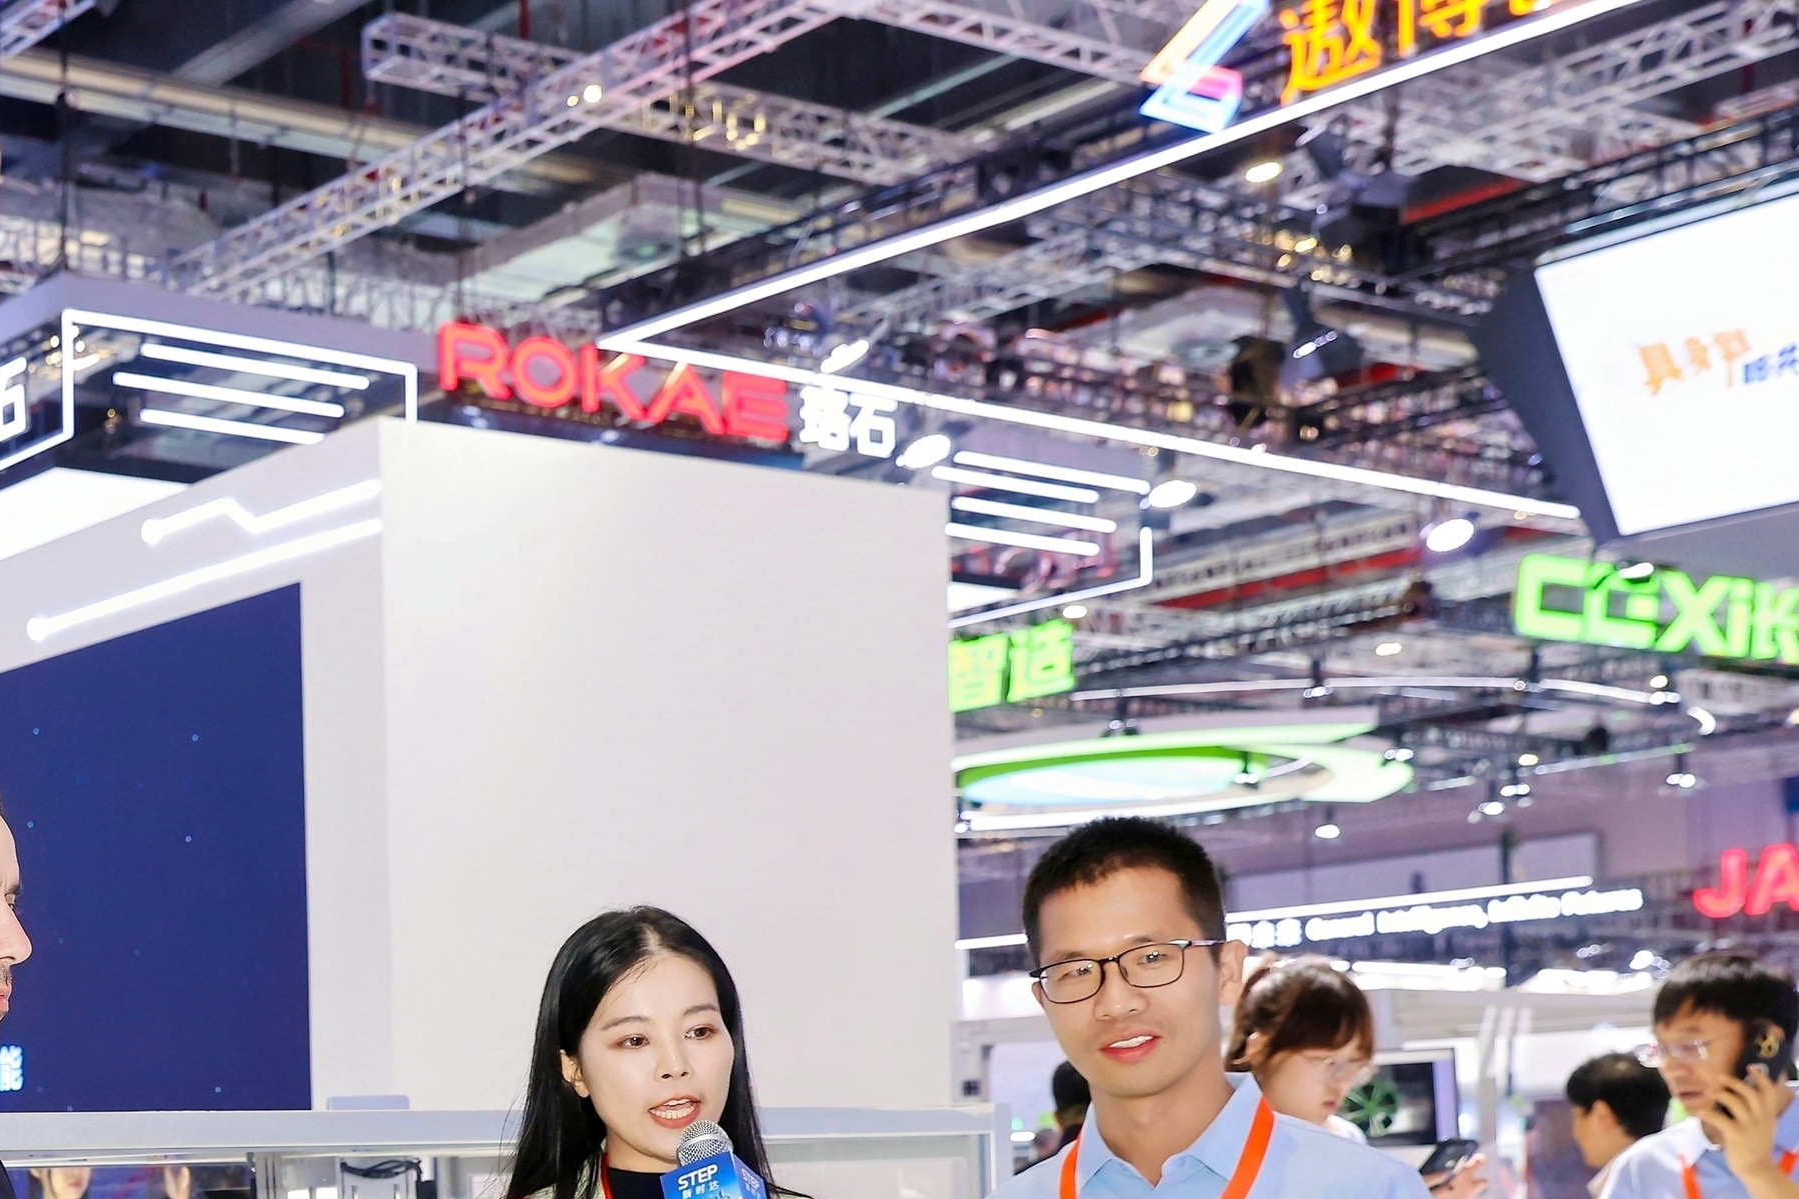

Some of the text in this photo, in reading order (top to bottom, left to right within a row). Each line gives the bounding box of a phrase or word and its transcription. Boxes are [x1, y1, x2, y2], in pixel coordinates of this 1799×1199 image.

[439, 320, 789, 444] ROKAE
[948, 618, 1075, 714] 智造
[678, 1163, 718, 1190] STEP
[682, 1180, 719, 1199] 新时达
